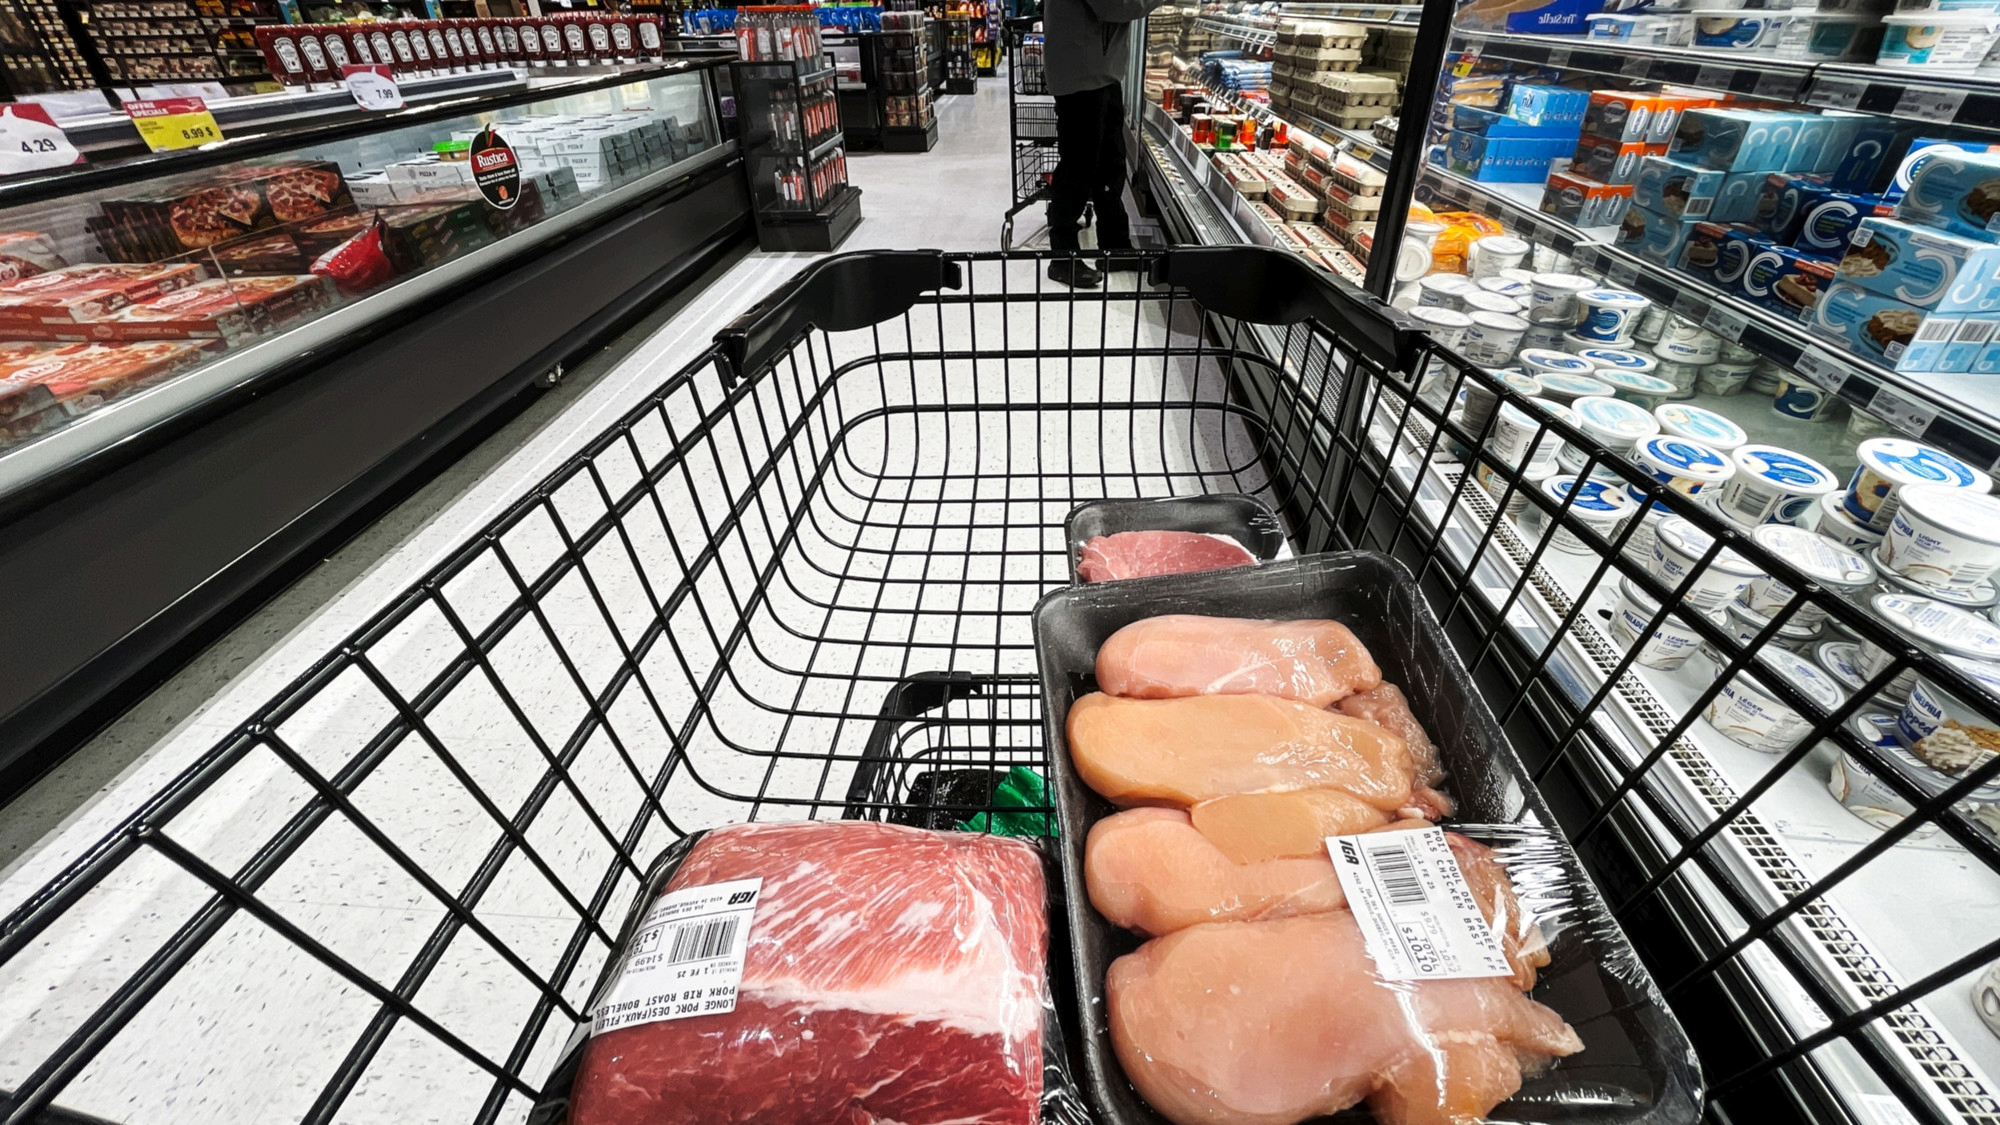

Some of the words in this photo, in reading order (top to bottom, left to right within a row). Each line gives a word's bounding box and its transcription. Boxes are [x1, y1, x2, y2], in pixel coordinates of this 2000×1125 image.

[375, 88, 394, 100] 7.99
[127, 102, 156, 111] OFFRE
[181, 127, 204, 140] 8.99
[205, 127, 214, 137] $
[20, 138, 57, 154] 4.29
[477, 152, 508, 168] Rustica
[1826, 371, 1842, 384] 4.99
[1908, 413, 1927, 427] 4.99
[1918, 533, 1942, 546] LIGHT
[1666, 558, 1683, 571] LIGHT
[1738, 695, 1764, 713] LÉGER
[1338, 839, 1360, 866] IGA
[1421, 868, 1429, 878] FE
[1427, 881, 1436, 890] 25
[727, 890, 757, 905] IGA
[1432, 830, 1449, 854] POIT
[1446, 859, 1462, 885] POUL
[1460, 891, 1476, 911] DES
[1473, 917, 1497, 951] PAREE
[1423, 833, 1438, 852] BLS
[1436, 859, 1465, 909] CHICKEN
[1463, 917, 1485, 947] BRST
[1483, 956, 1496, 971] FF
[1402, 926, 1433, 973] $10.10
[1420, 937, 1440, 970] TOTAL
[635, 953, 663, 967] $14.99
[677, 971, 687, 979] 25
[689, 969, 700, 977] FE
[683, 989, 703, 1000] RIB
[709, 986, 736, 996] PORK
[646, 992, 677, 1006] ROAST
[704, 998, 734, 1010] LONGE
[596, 998, 640, 1018] BONELESS
[675, 1002, 699, 1014] PORC
